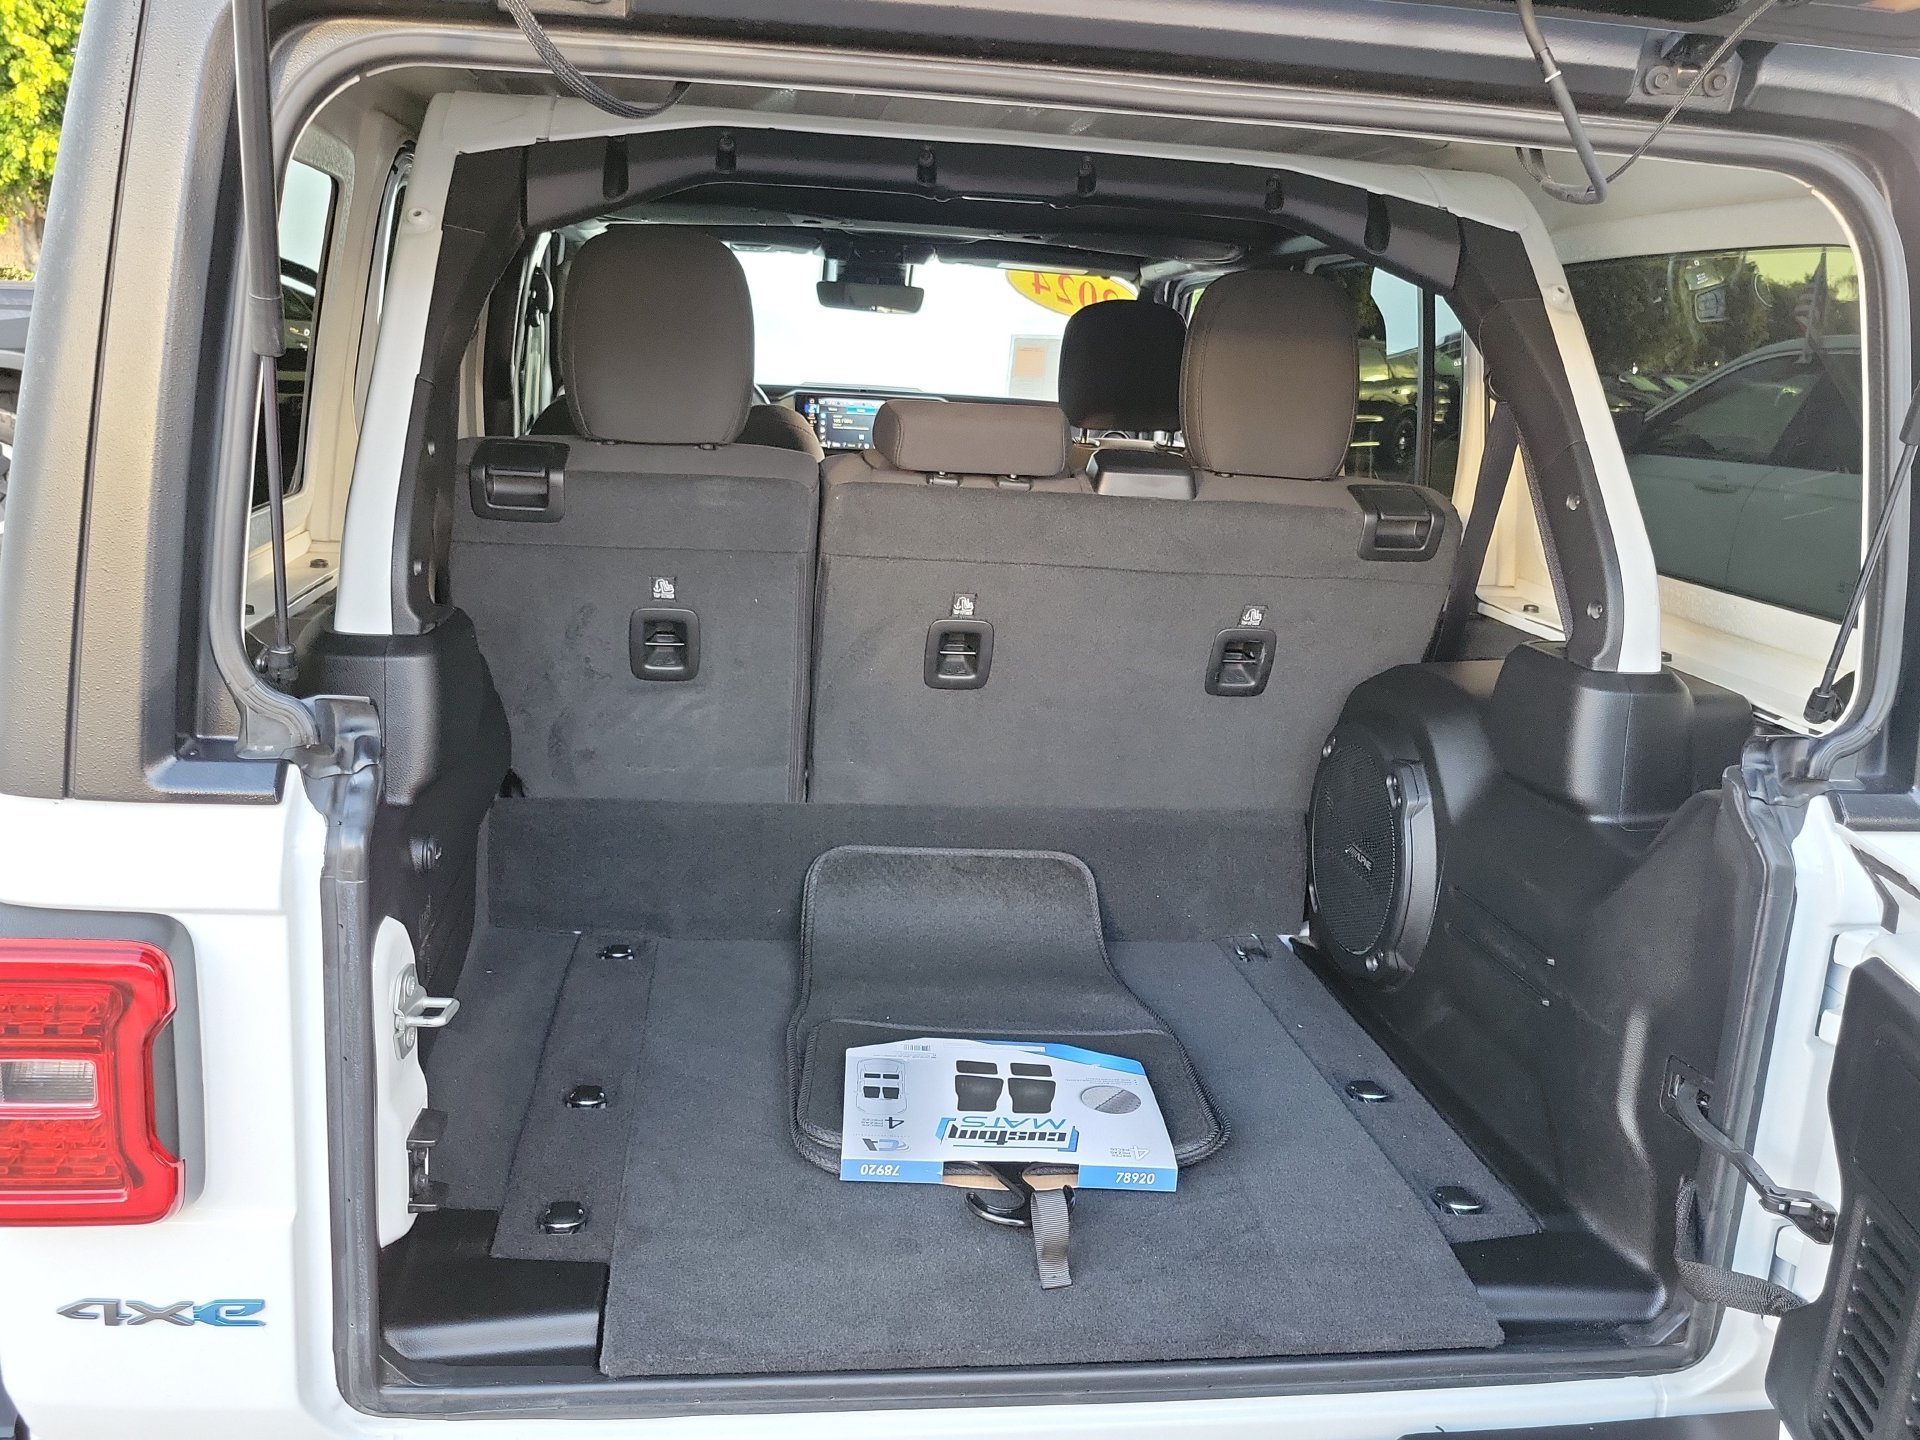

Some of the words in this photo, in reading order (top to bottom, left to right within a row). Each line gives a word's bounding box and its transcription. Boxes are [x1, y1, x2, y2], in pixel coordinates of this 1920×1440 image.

[884, 1117, 905, 1130] 4
[961, 1115, 1067, 1130] MATS
[947, 1123, 1067, 1146] custom
[860, 1163, 901, 1177] 78920
[1115, 1171, 1156, 1185] 78920
[55, 1297, 267, 1327] 4xe
